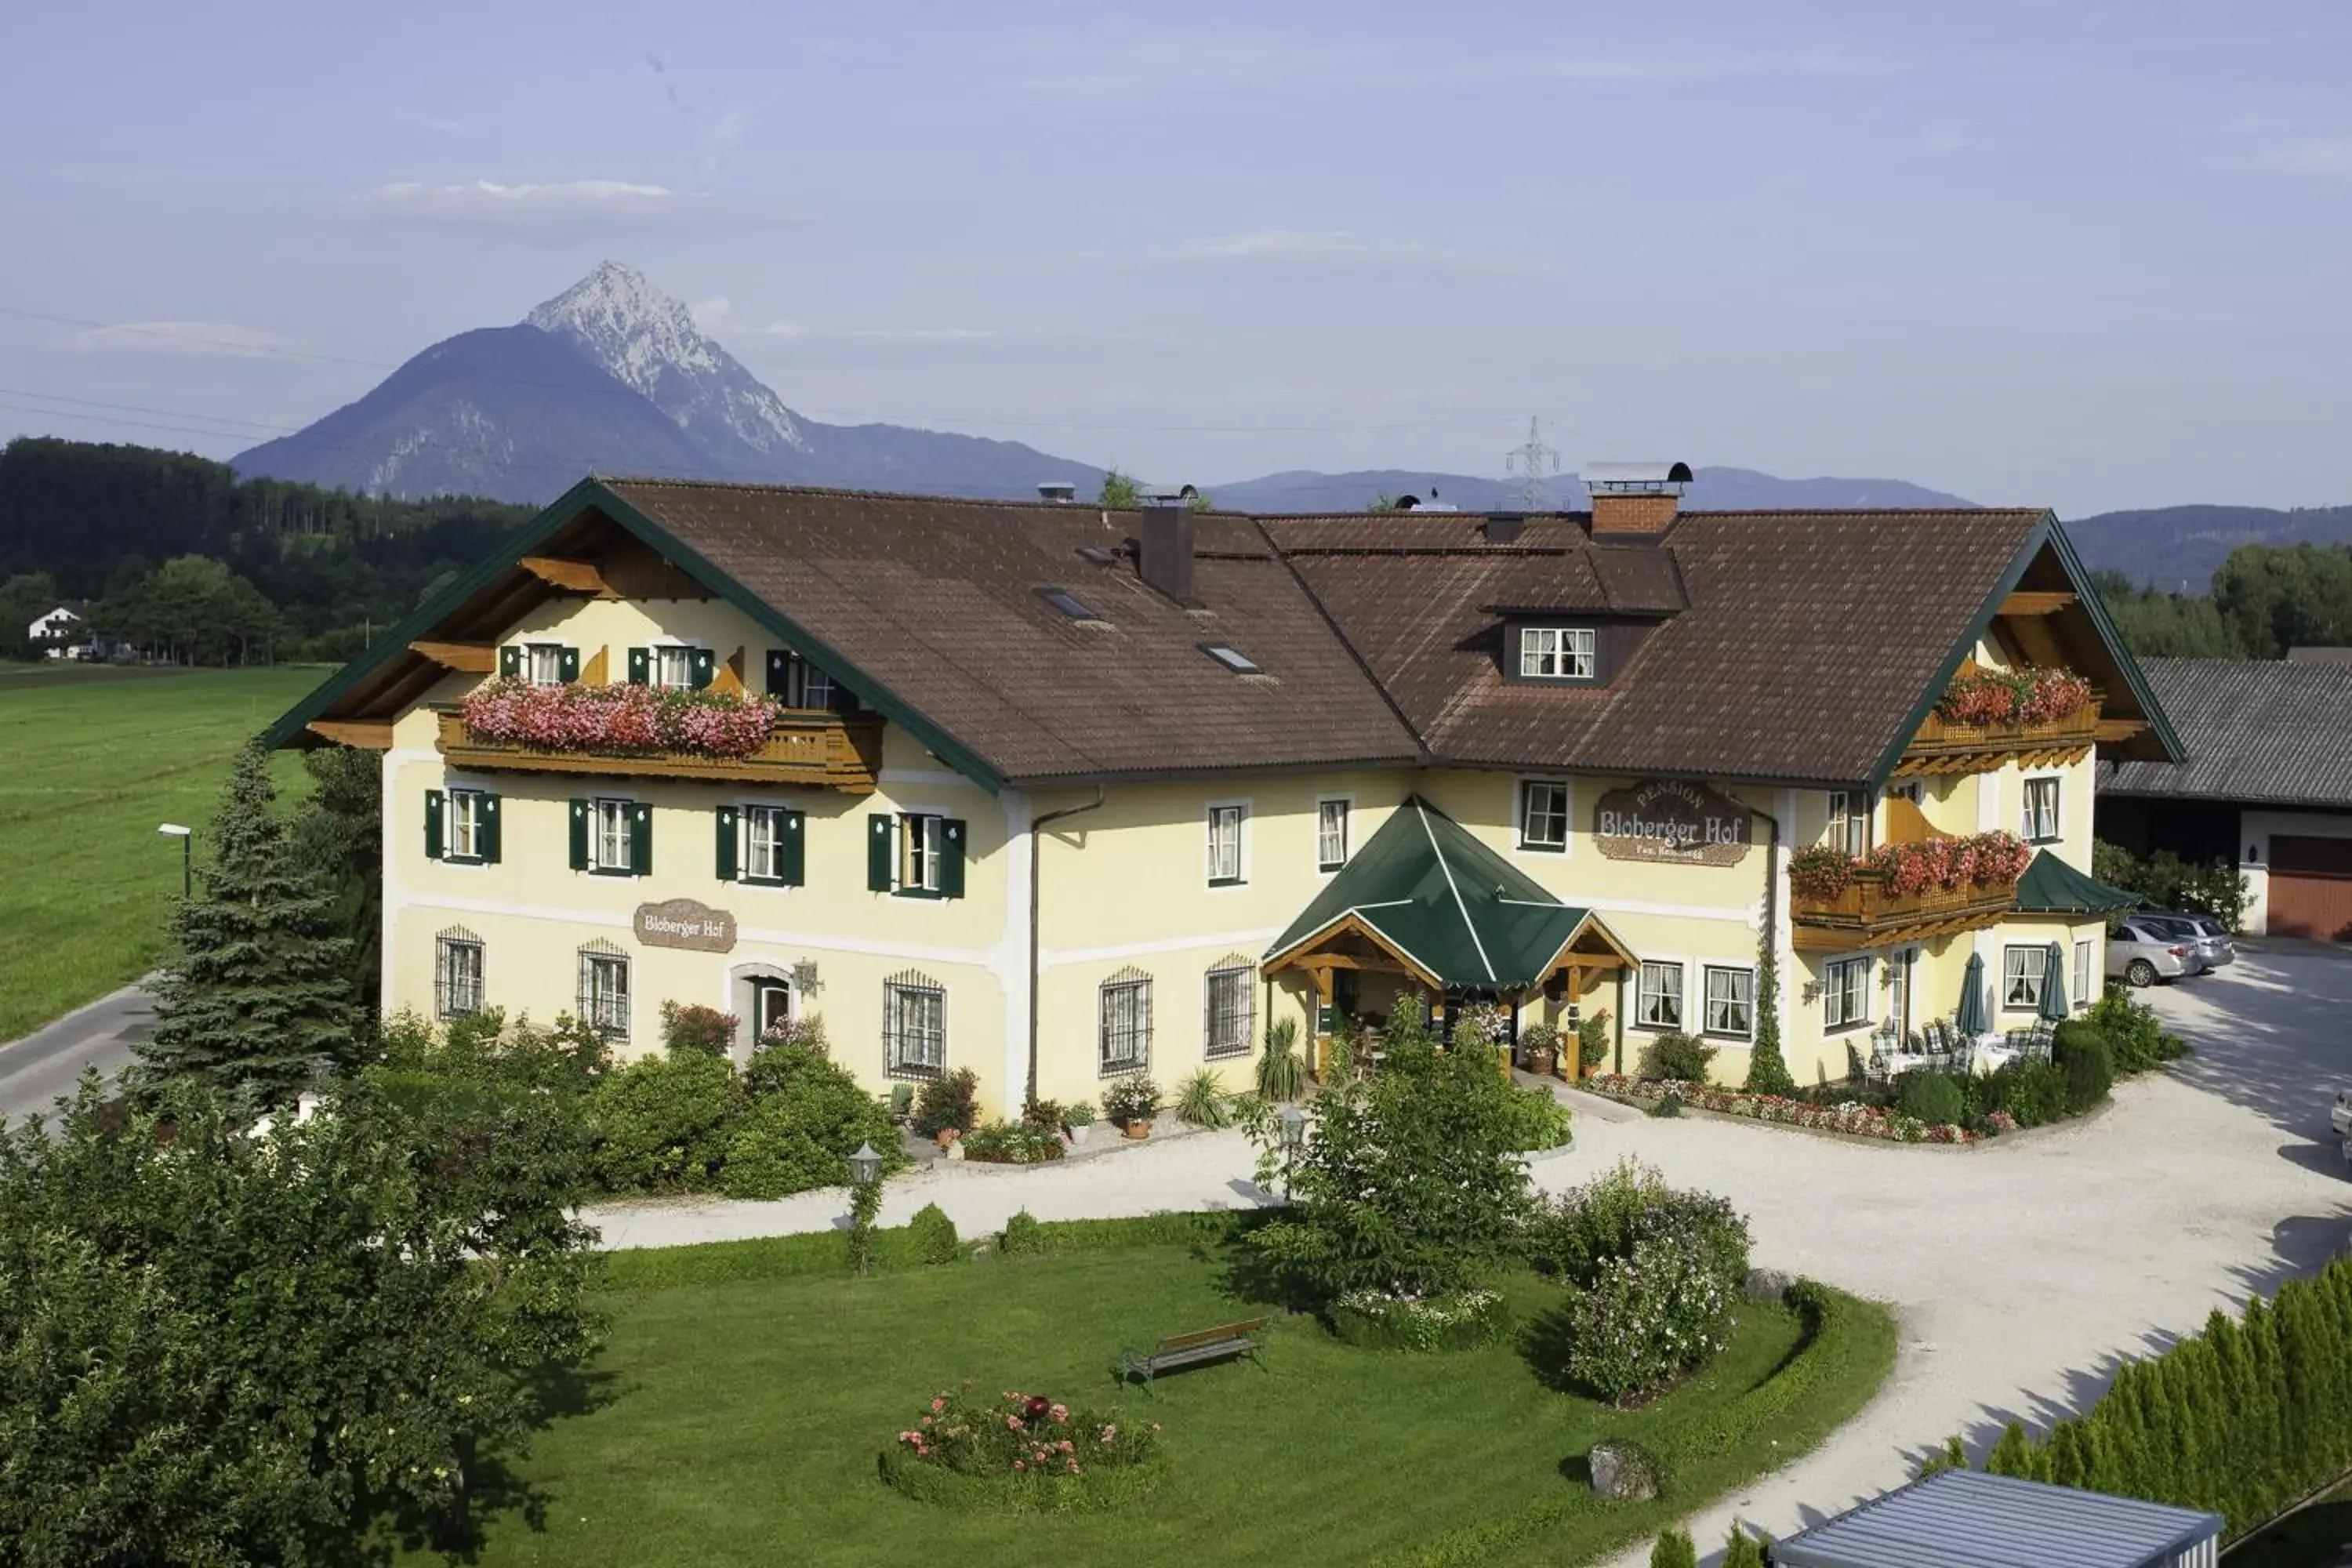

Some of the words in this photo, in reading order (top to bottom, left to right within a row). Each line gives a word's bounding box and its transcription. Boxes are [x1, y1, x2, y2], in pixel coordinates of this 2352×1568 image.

[1599, 811, 1699, 848] Bloberger
[1704, 815, 1743, 845] Hof
[644, 915, 700, 938] Bloberger
[702, 920, 725, 938] Hof
